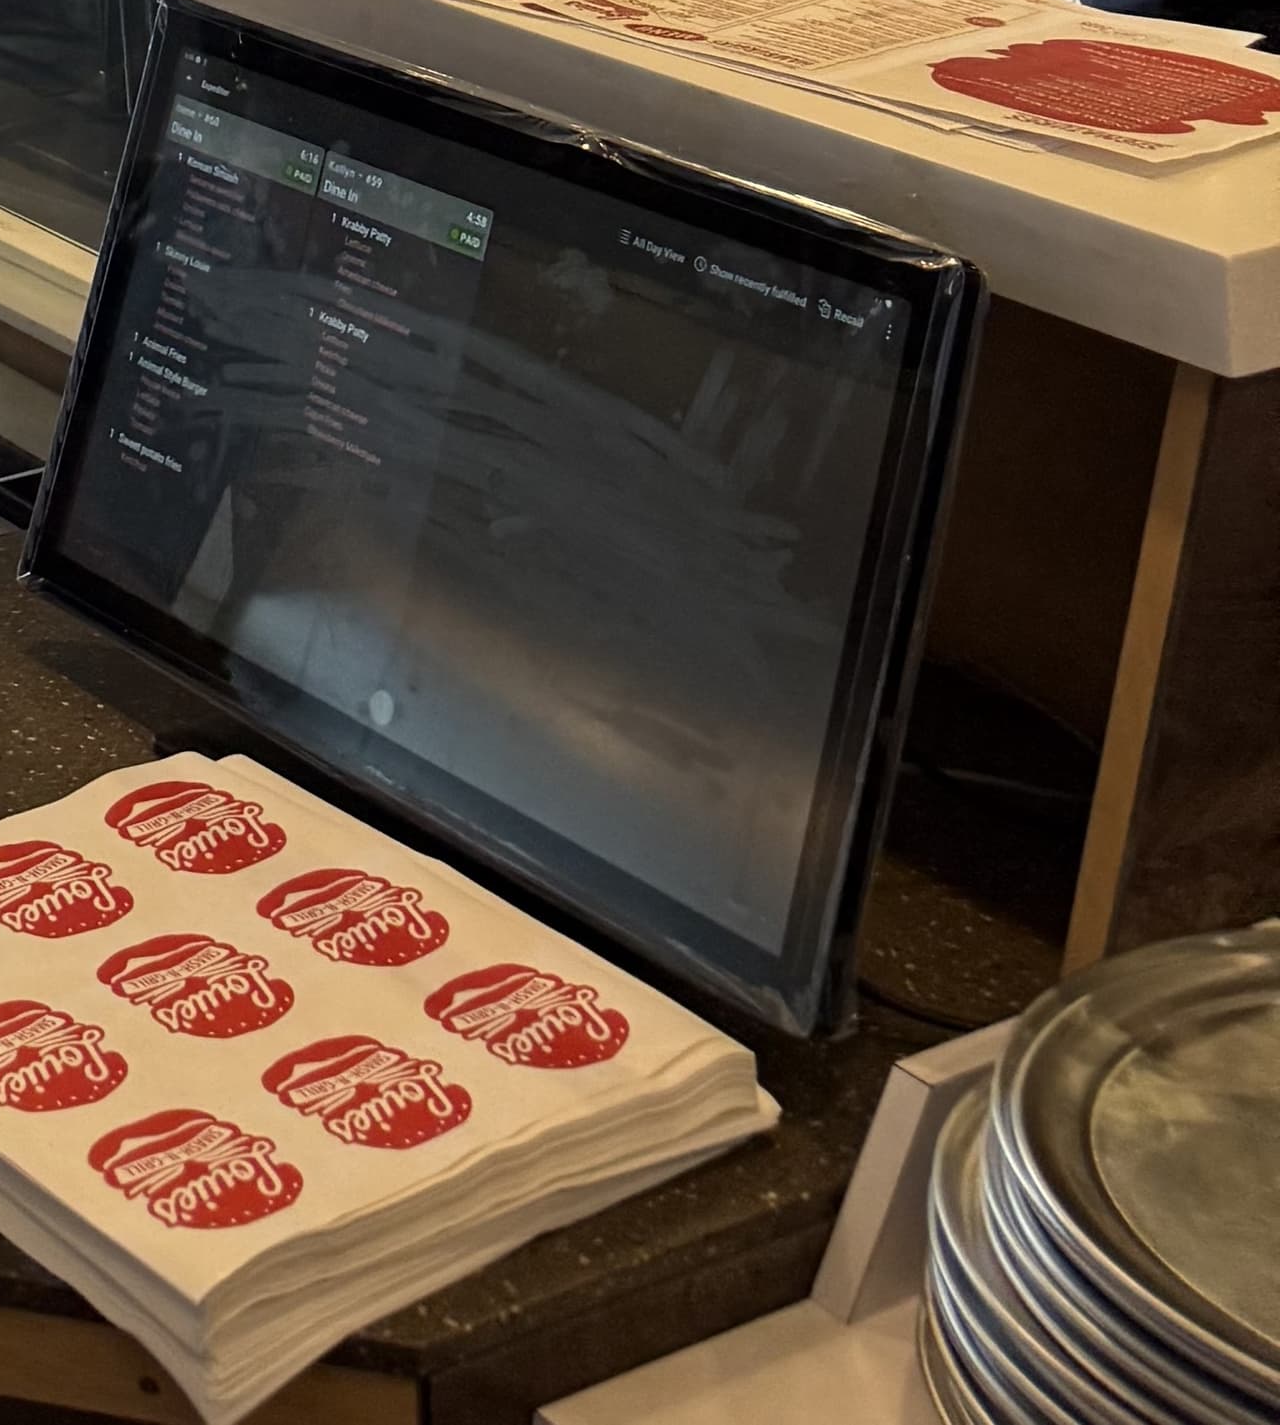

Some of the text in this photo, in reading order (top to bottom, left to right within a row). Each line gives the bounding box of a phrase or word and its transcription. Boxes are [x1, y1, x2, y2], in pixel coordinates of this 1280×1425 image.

[169, 120, 204, 144] Dine In
[322, 179, 359, 204] Dine In
[330, 212, 392, 248] 1 Krabby Patty
[458, 231, 481, 249] PAID
[464, 210, 488, 228] 4:58
[632, 234, 686, 264] All Day View
[709, 263, 808, 309] Show recently fulfilled
[307, 307, 314, 317] 1
[317, 310, 347, 334] Krabby
[345, 322, 370, 344] Patty
[117, 432, 142, 452] Sweet
[139, 444, 166, 465] potato
[137, 793, 221, 834] SMASH-N-GRILL
[160, 803, 270, 870] Louie's
[3, 865, 116, 931] Louie's
[288, 880, 376, 924] SMASH-N-GRILL
[317, 890, 433, 960] Louie's
[132, 946, 223, 991] SMASH-N-GRILL
[156, 957, 276, 1032] Louie's
[459, 978, 550, 1026] SMASH-N-GRILL
[492, 987, 611, 1064] Louie's
[299, 1051, 392, 1099] SMASH-N-GRILL
[329, 1061, 453, 1143] Louie's
[125, 1124, 223, 1175] SMASH-N-GRILL
[154, 1140, 283, 1224] Louie's
